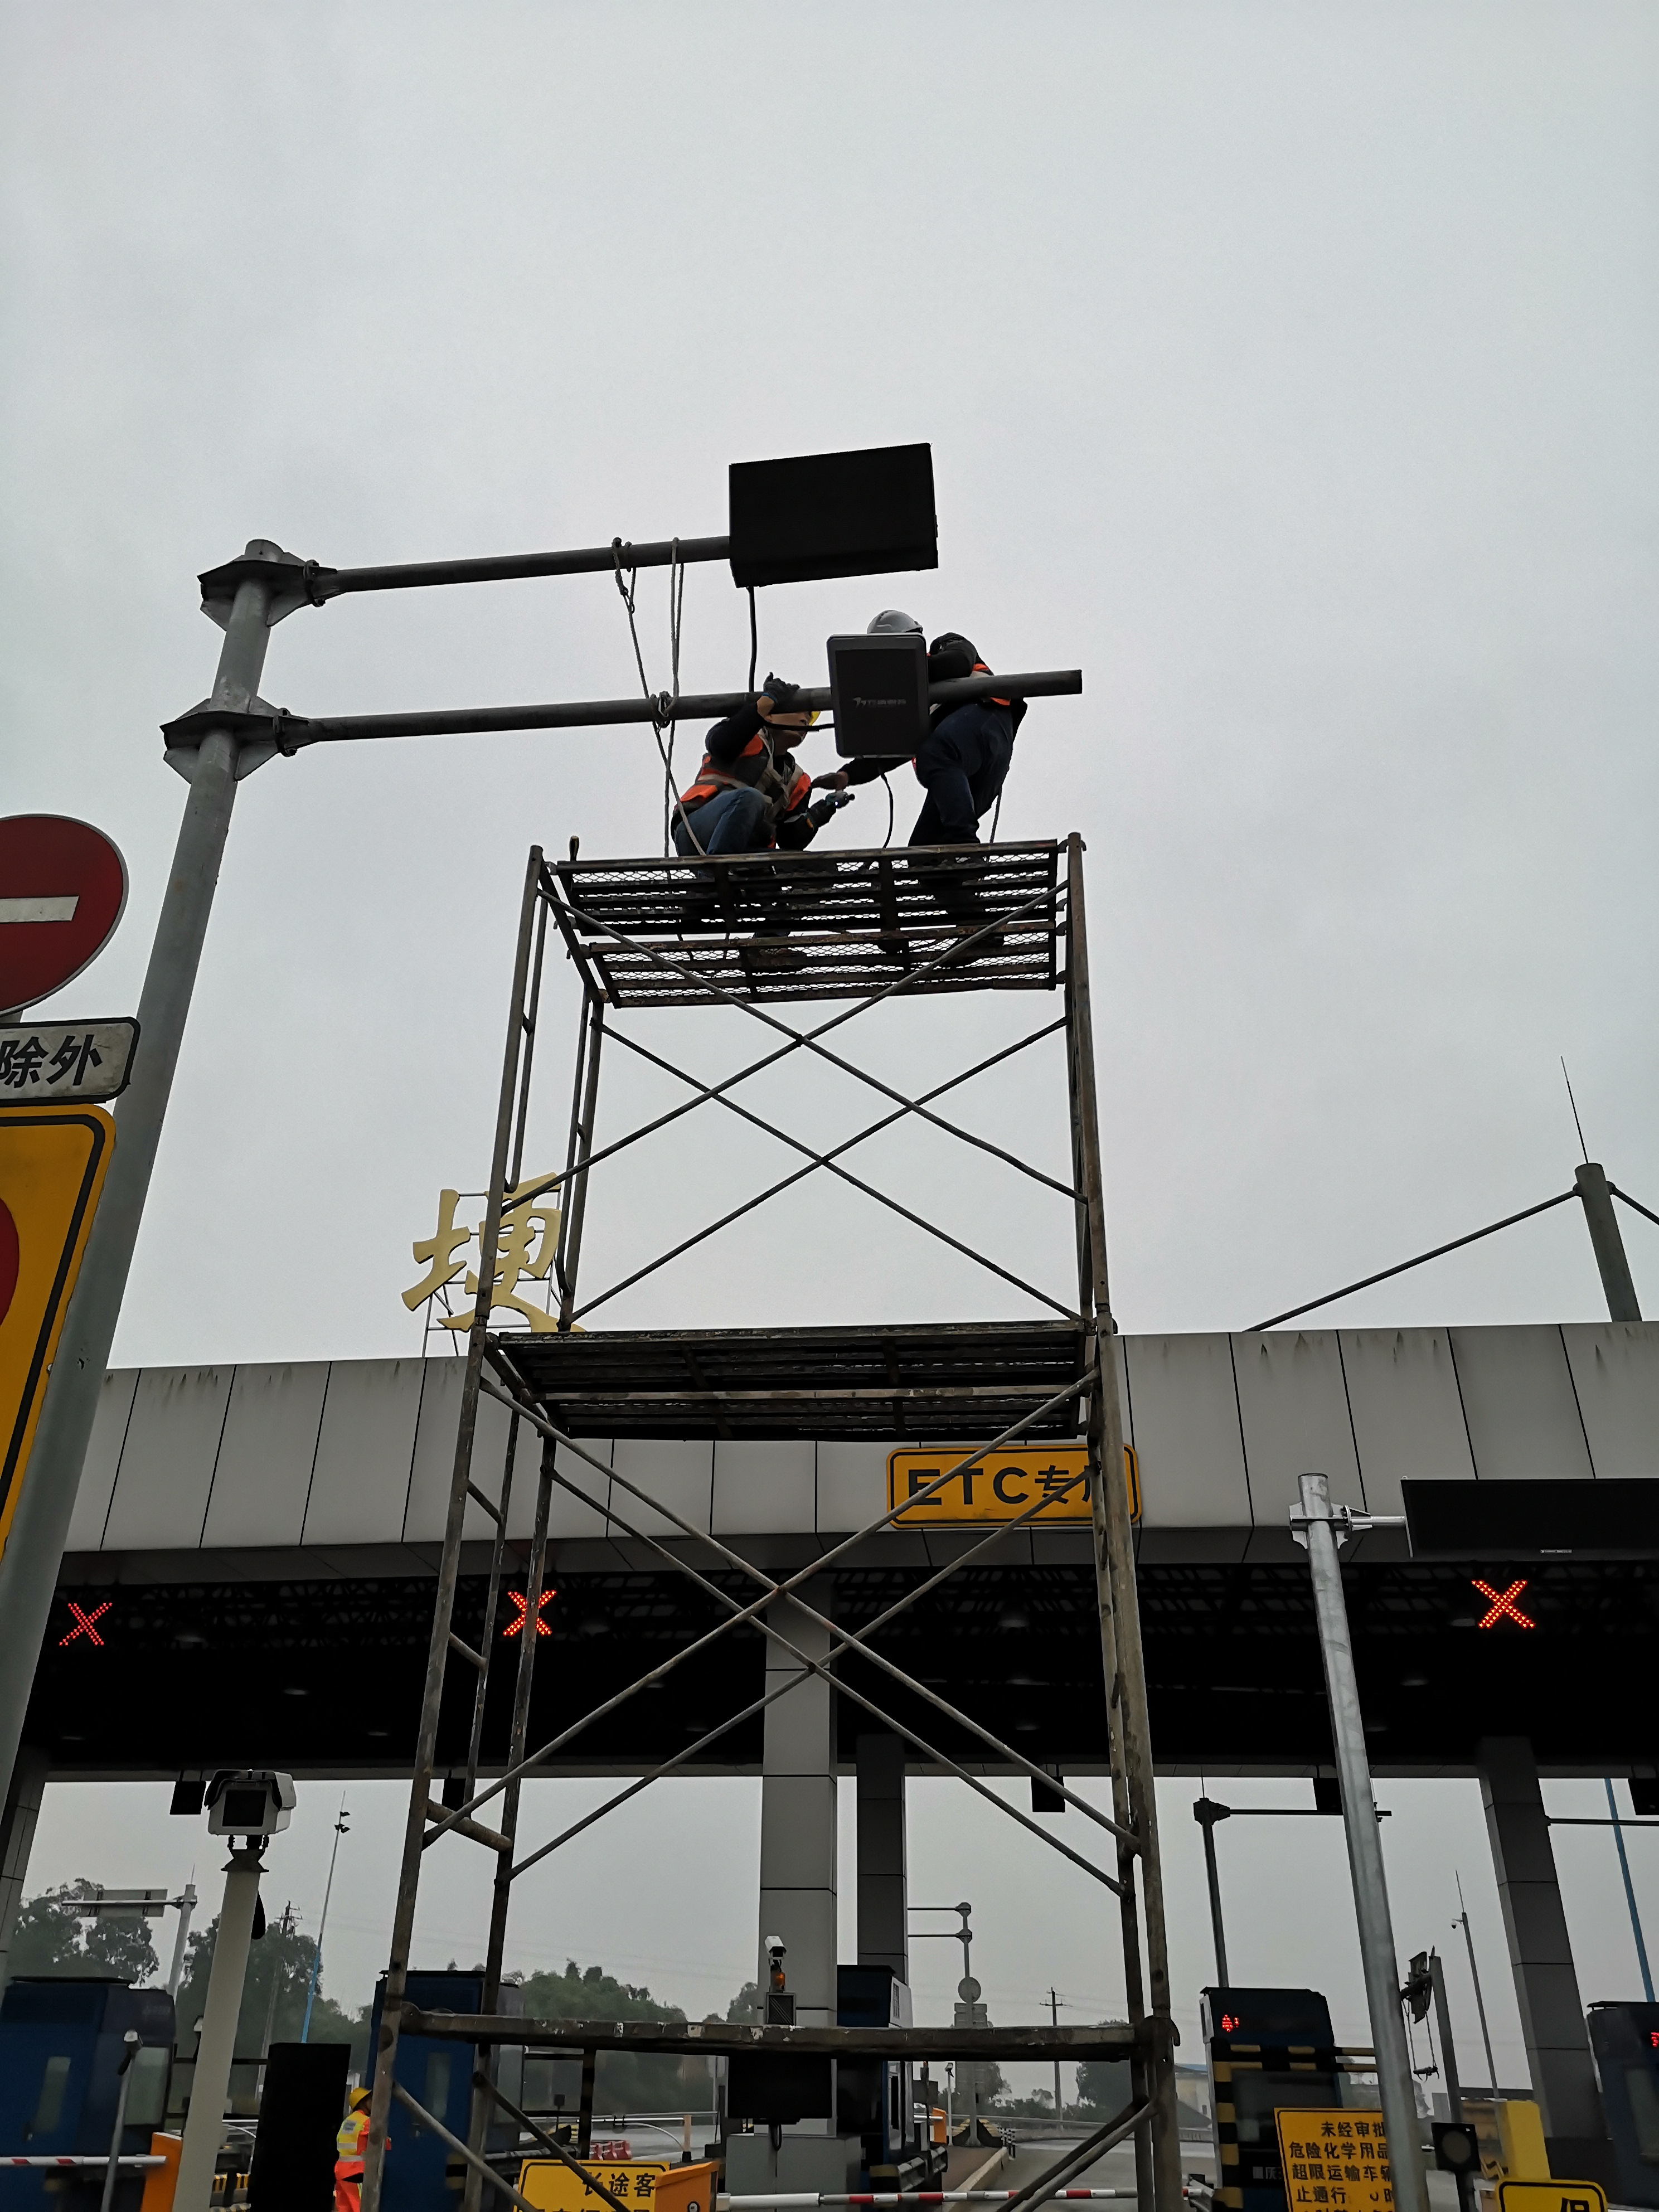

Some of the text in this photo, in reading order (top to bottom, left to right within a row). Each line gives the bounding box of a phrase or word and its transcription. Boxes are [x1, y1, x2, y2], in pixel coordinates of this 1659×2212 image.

[0, 1034, 103, 1088] 除外
[908, 1465, 1092, 1505] ETC专
[1296, 2185, 1346, 2204] 止通行
